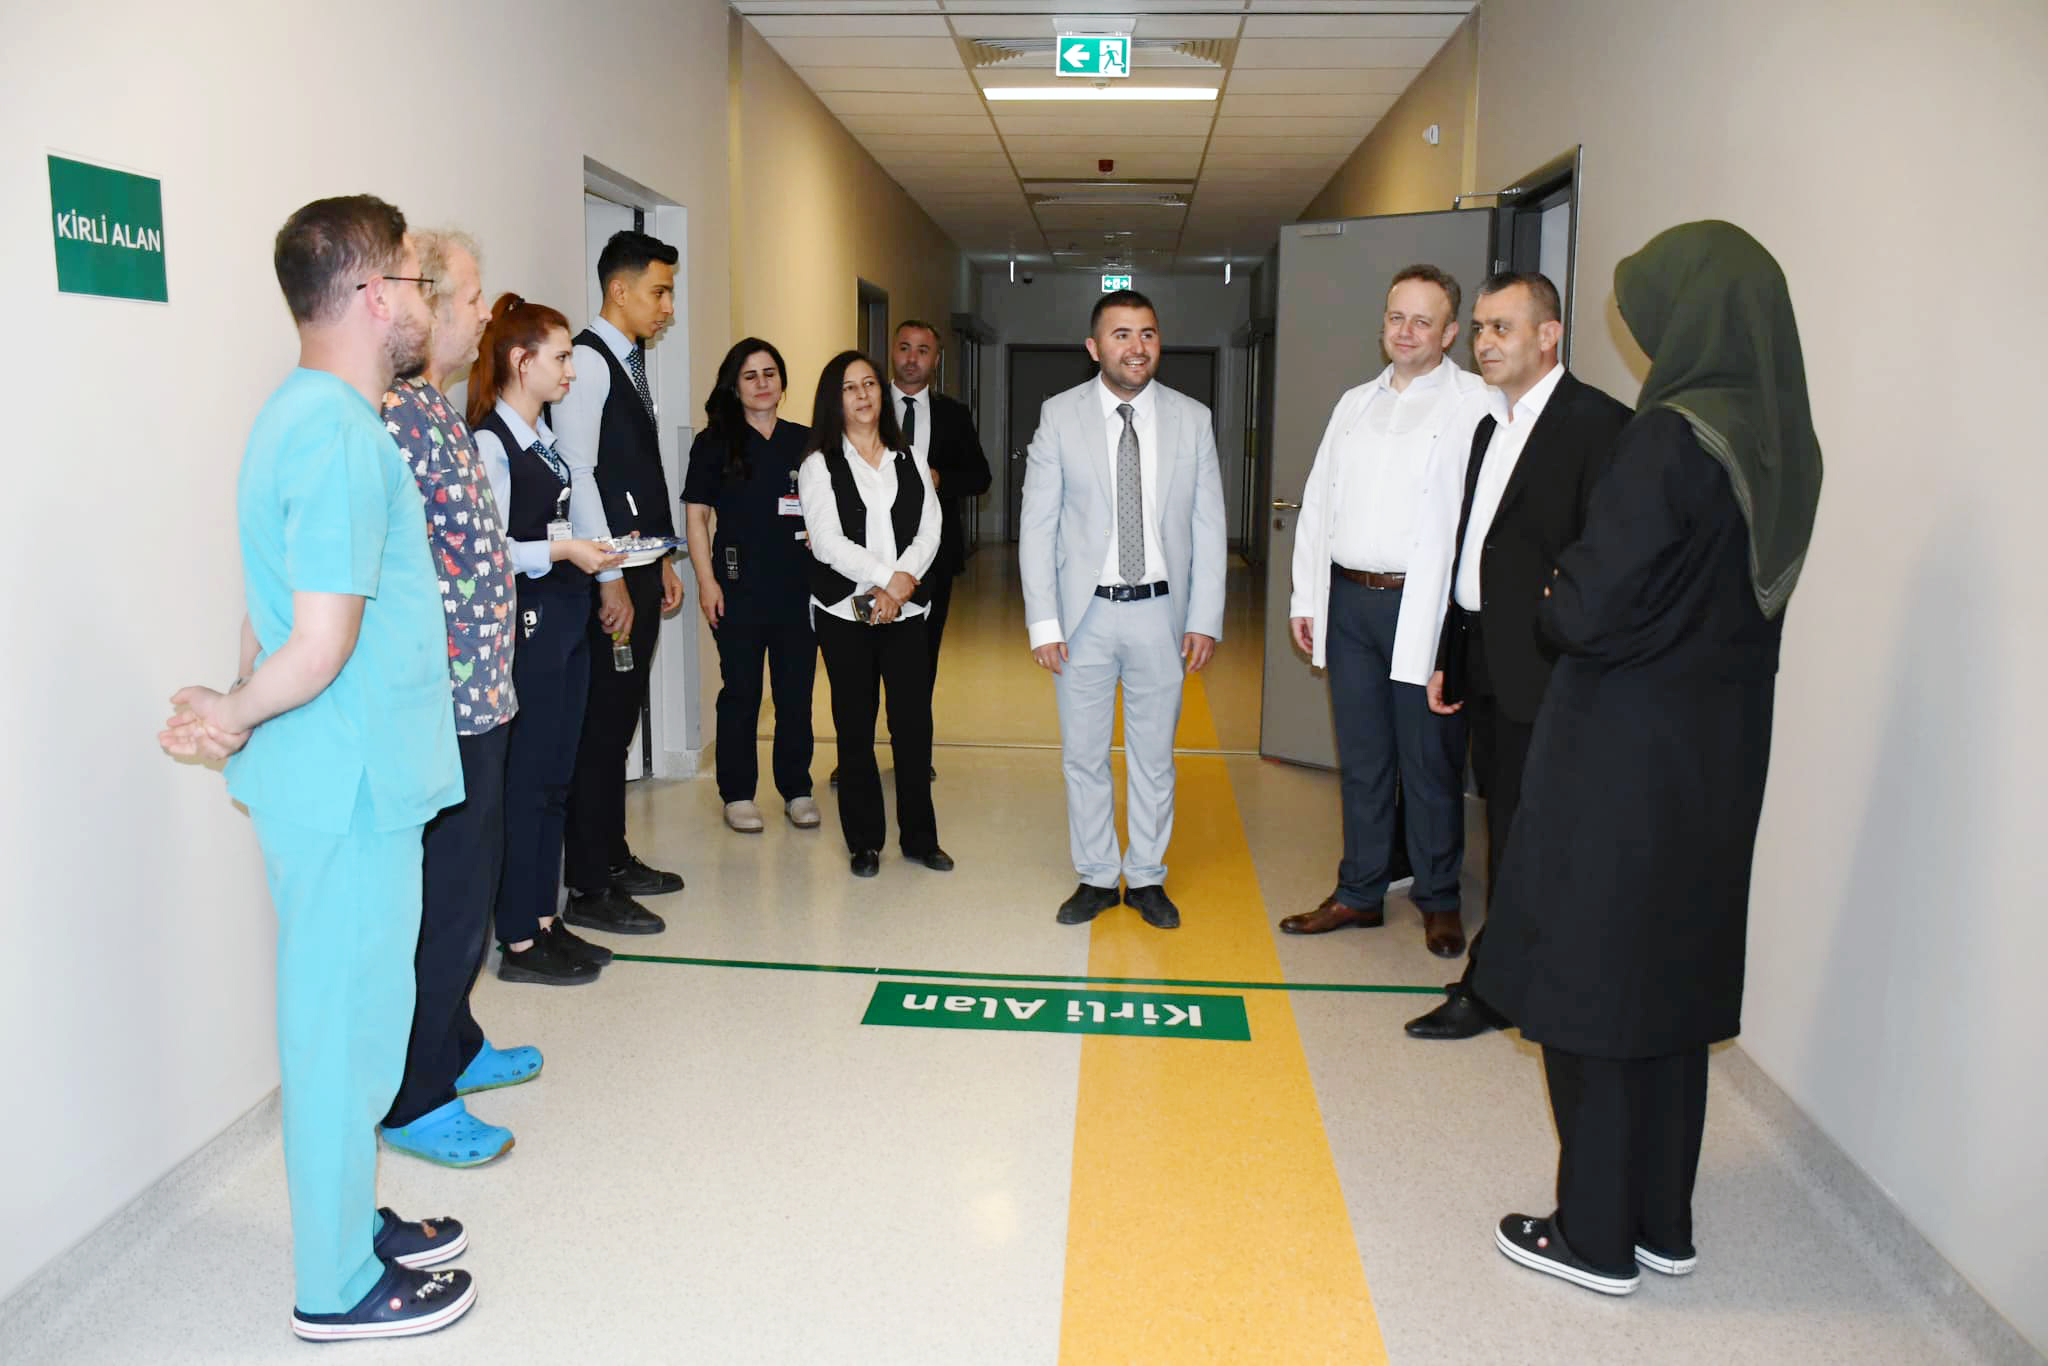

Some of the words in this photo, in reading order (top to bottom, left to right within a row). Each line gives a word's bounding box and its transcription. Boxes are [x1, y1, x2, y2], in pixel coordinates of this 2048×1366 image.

[57, 208, 107, 244] KİRLİ
[112, 222, 160, 252] ALAN
[902, 994, 1047, 1020] Alan
[1067, 1000, 1202, 1027] Kirli
